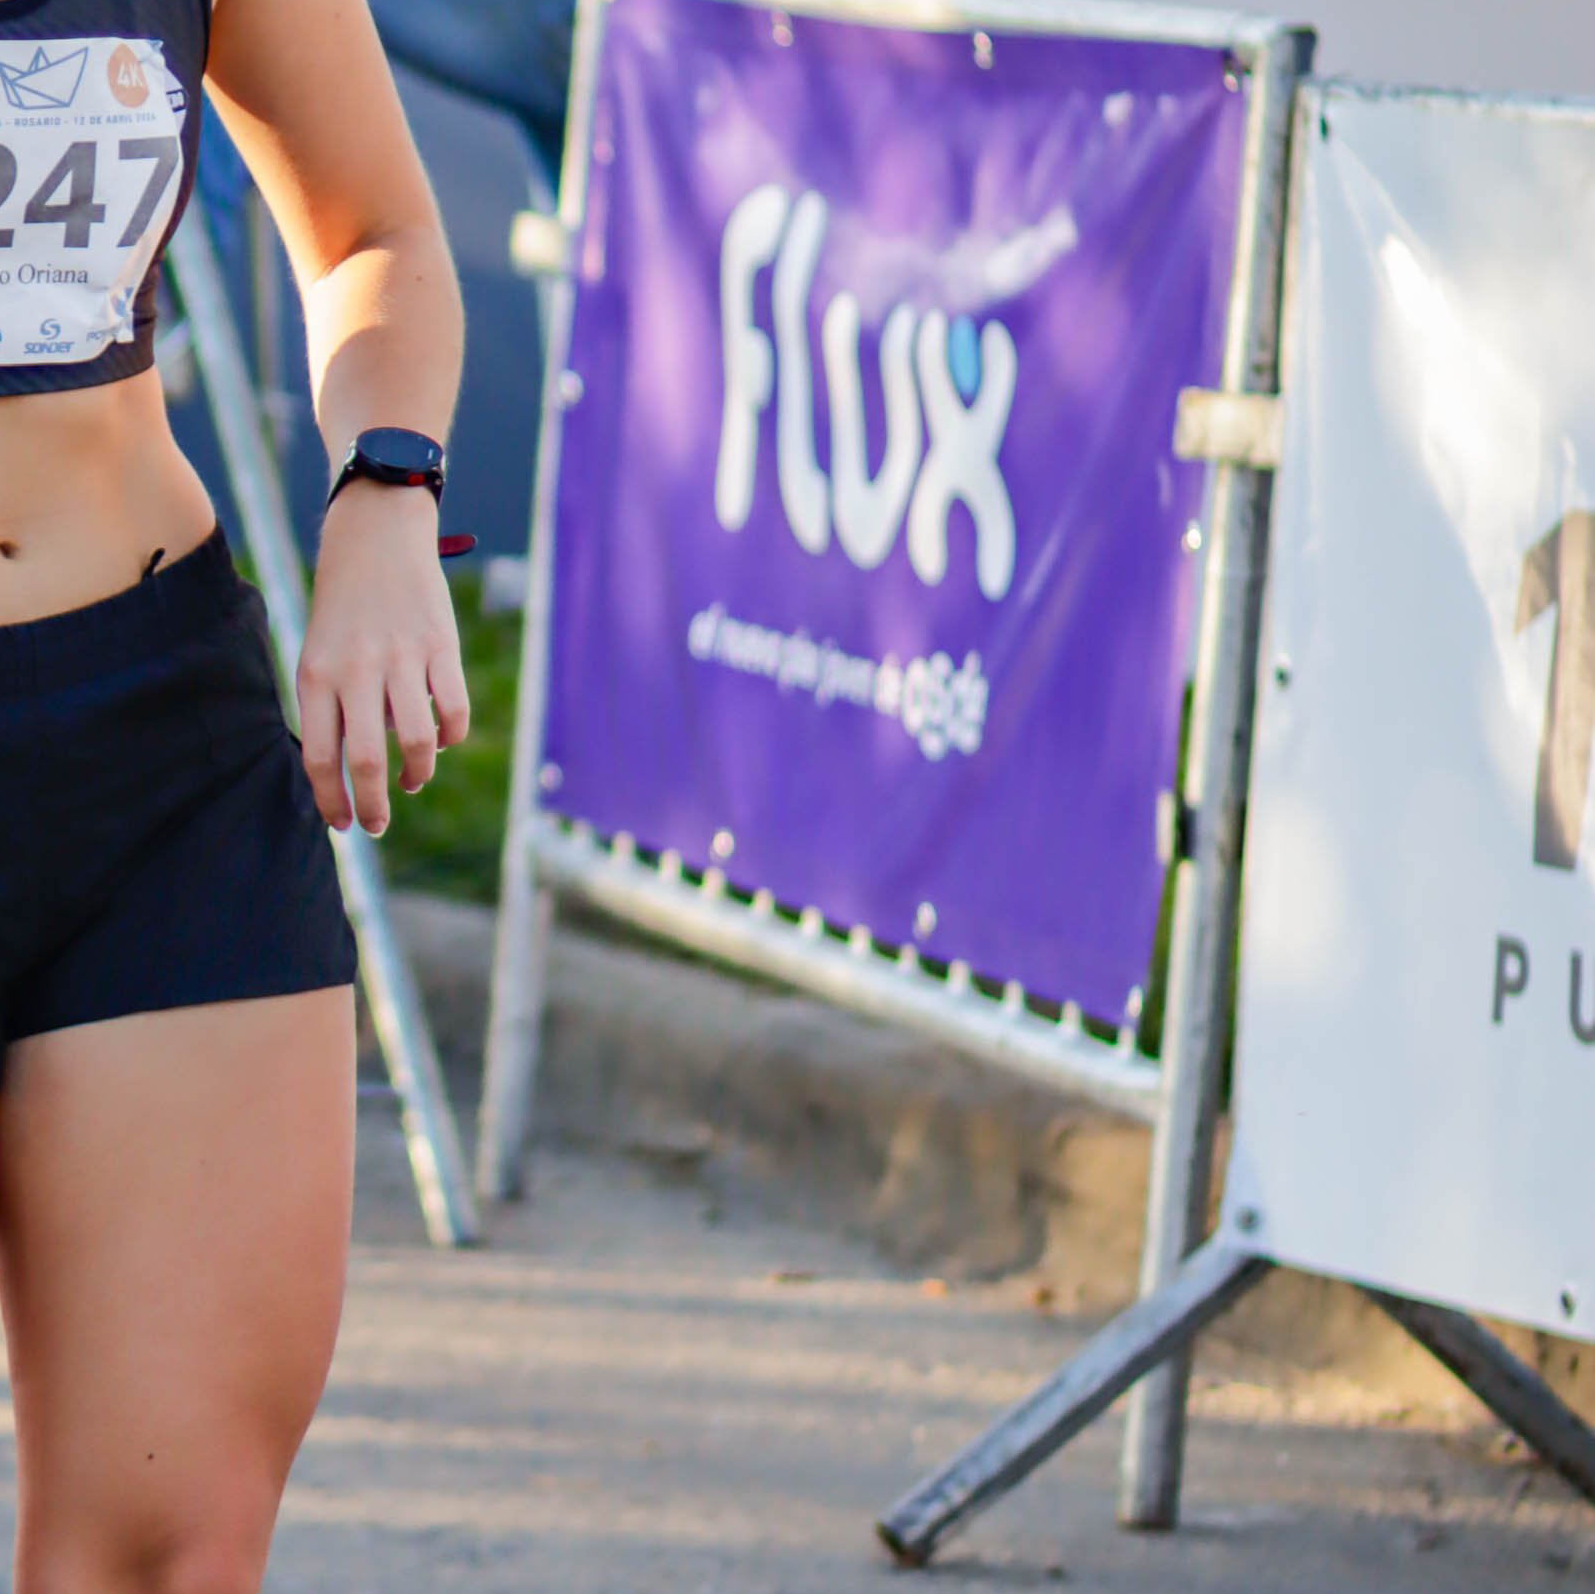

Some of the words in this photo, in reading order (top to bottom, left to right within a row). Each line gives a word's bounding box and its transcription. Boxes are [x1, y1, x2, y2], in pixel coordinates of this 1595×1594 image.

[117, 61, 147, 86] 4K
[14, 117, 61, 127] ROSARIO
[74, 116, 85, 126] 12
[90, 115, 103, 125] DE
[106, 114, 132, 125] ABRIL
[17, 262, 88, 285] Oriana
